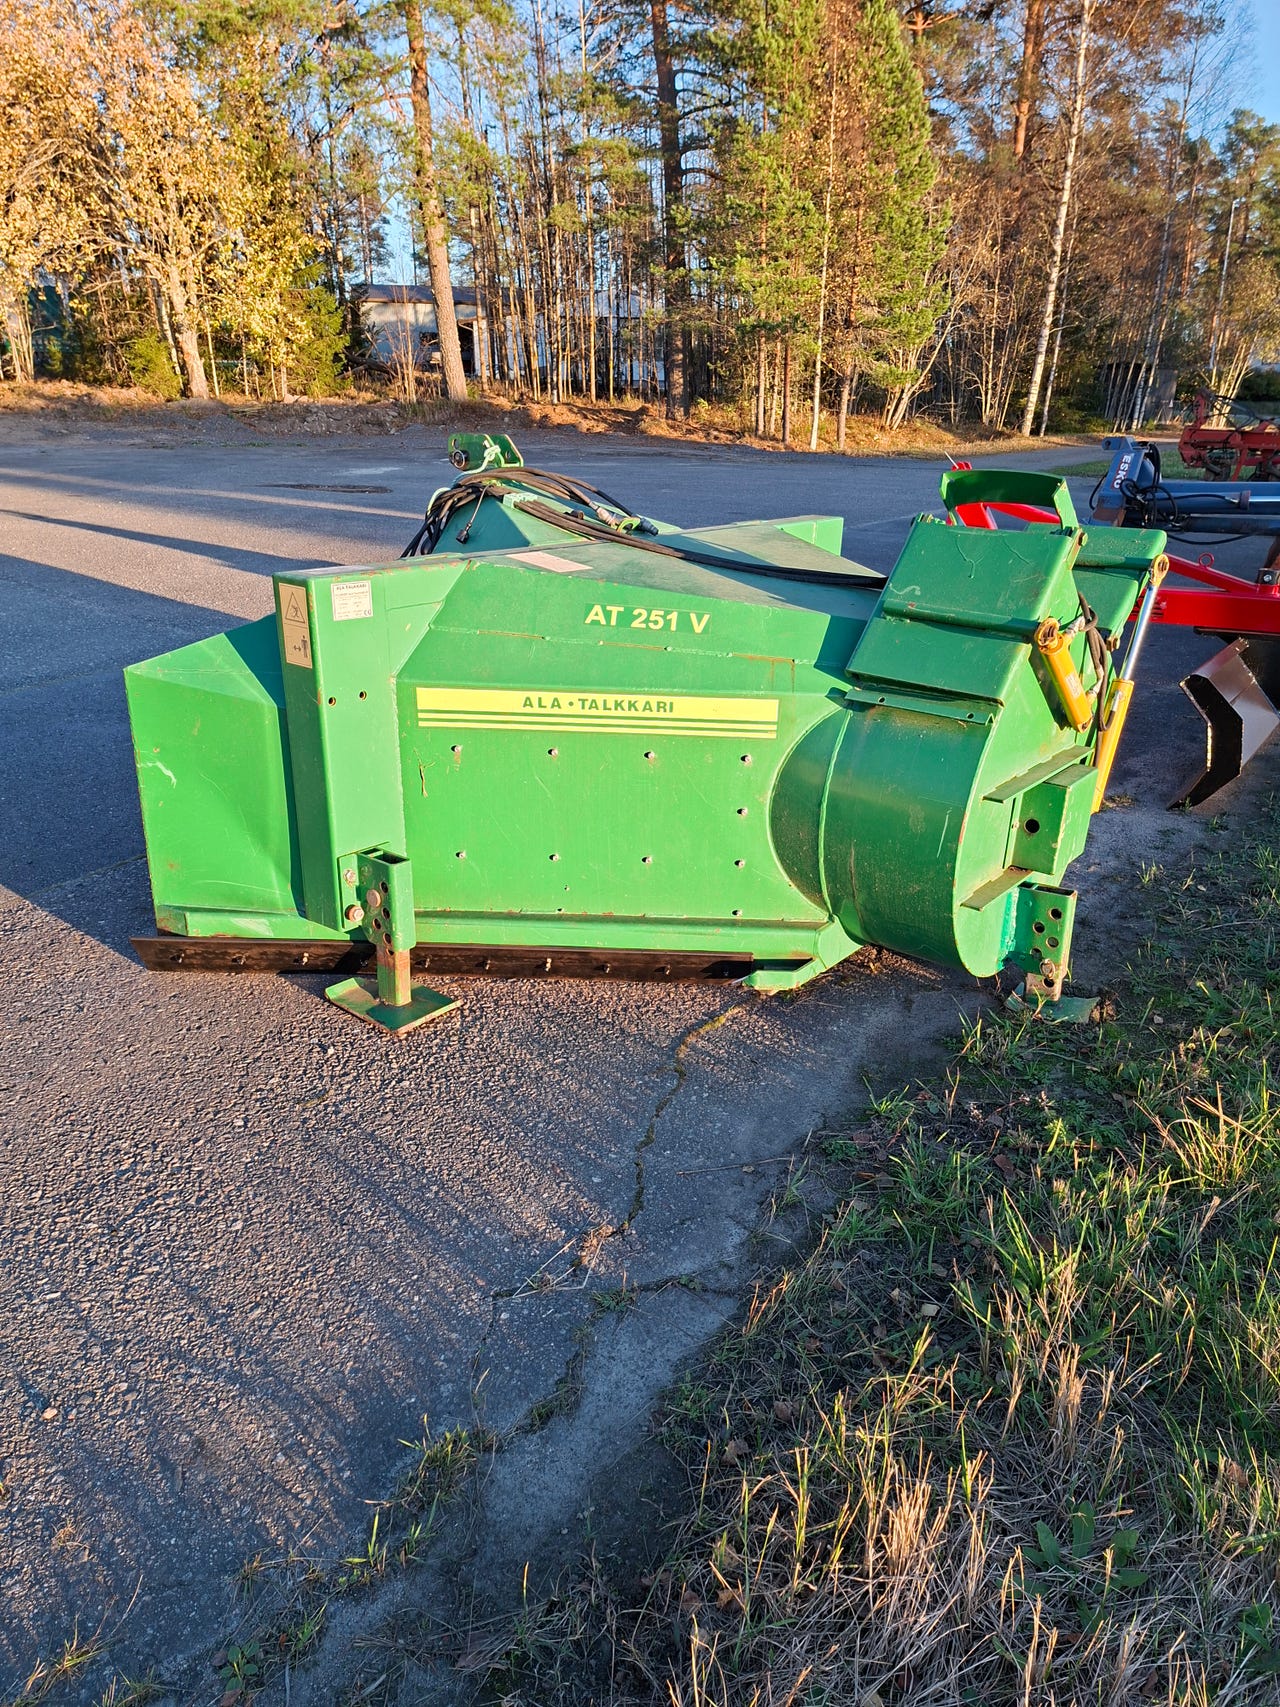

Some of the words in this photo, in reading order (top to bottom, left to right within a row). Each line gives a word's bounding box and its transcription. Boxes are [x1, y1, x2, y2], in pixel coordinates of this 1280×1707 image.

[1113, 454, 1132, 489] ESKO
[584, 604, 625, 627] AT
[630, 608, 679, 632] 251
[689, 612, 711, 634] V
